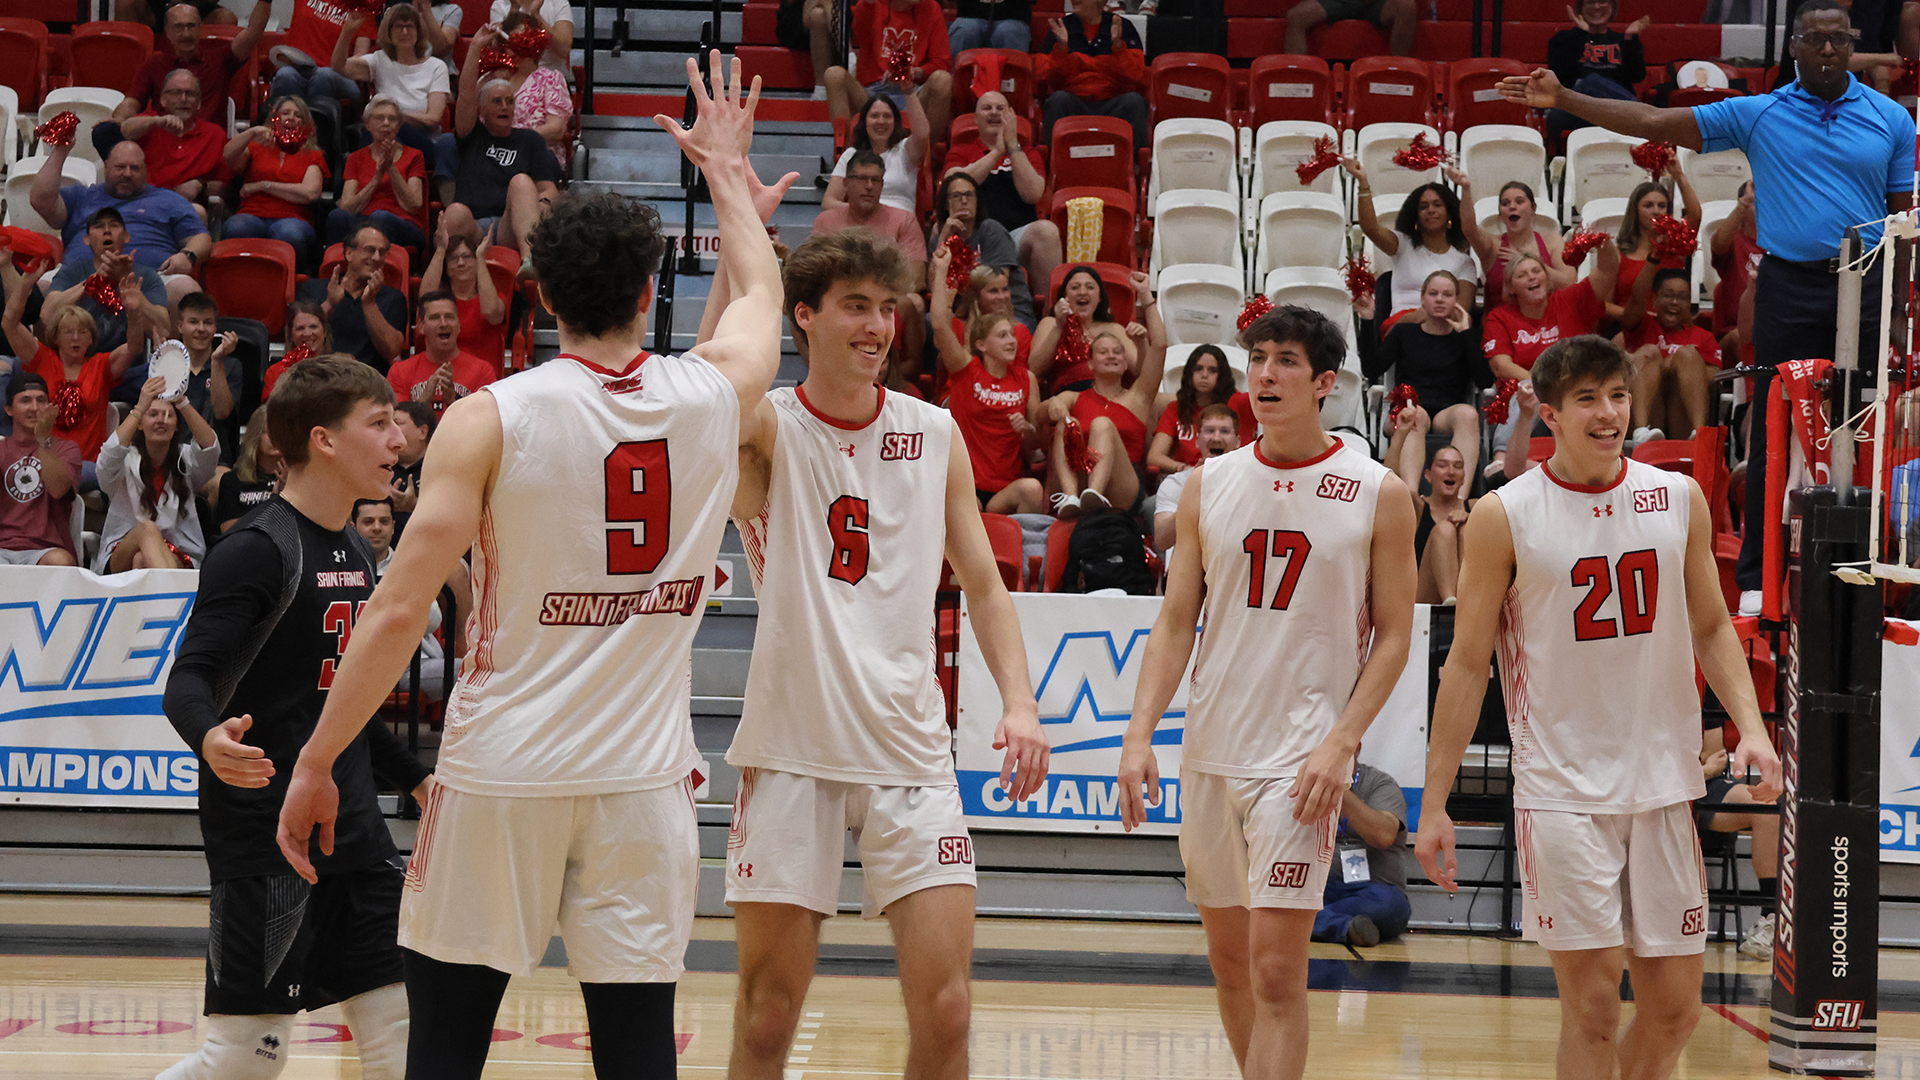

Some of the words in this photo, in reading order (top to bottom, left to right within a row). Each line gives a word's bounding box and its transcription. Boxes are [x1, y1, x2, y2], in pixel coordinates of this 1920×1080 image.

[881, 432, 923, 461] SFU
[604, 438, 671, 575] 9
[1316, 473, 1361, 502] SFU
[1633, 487, 1668, 513] SFU
[827, 494, 870, 586] 6
[1243, 528, 1312, 611] 17
[1571, 548, 1658, 641] 20
[540, 592, 610, 626] SAINT
[0, 592, 197, 693] NE
[318, 601, 368, 690] 3
[0, 752, 199, 791] MPIONS
[938, 836, 972, 865] SFU
[1269, 862, 1310, 888] SFU
[1831, 835, 1850, 898] sports
[1829, 901, 1849, 978] imports
[1812, 1000, 1865, 1031] SFU
